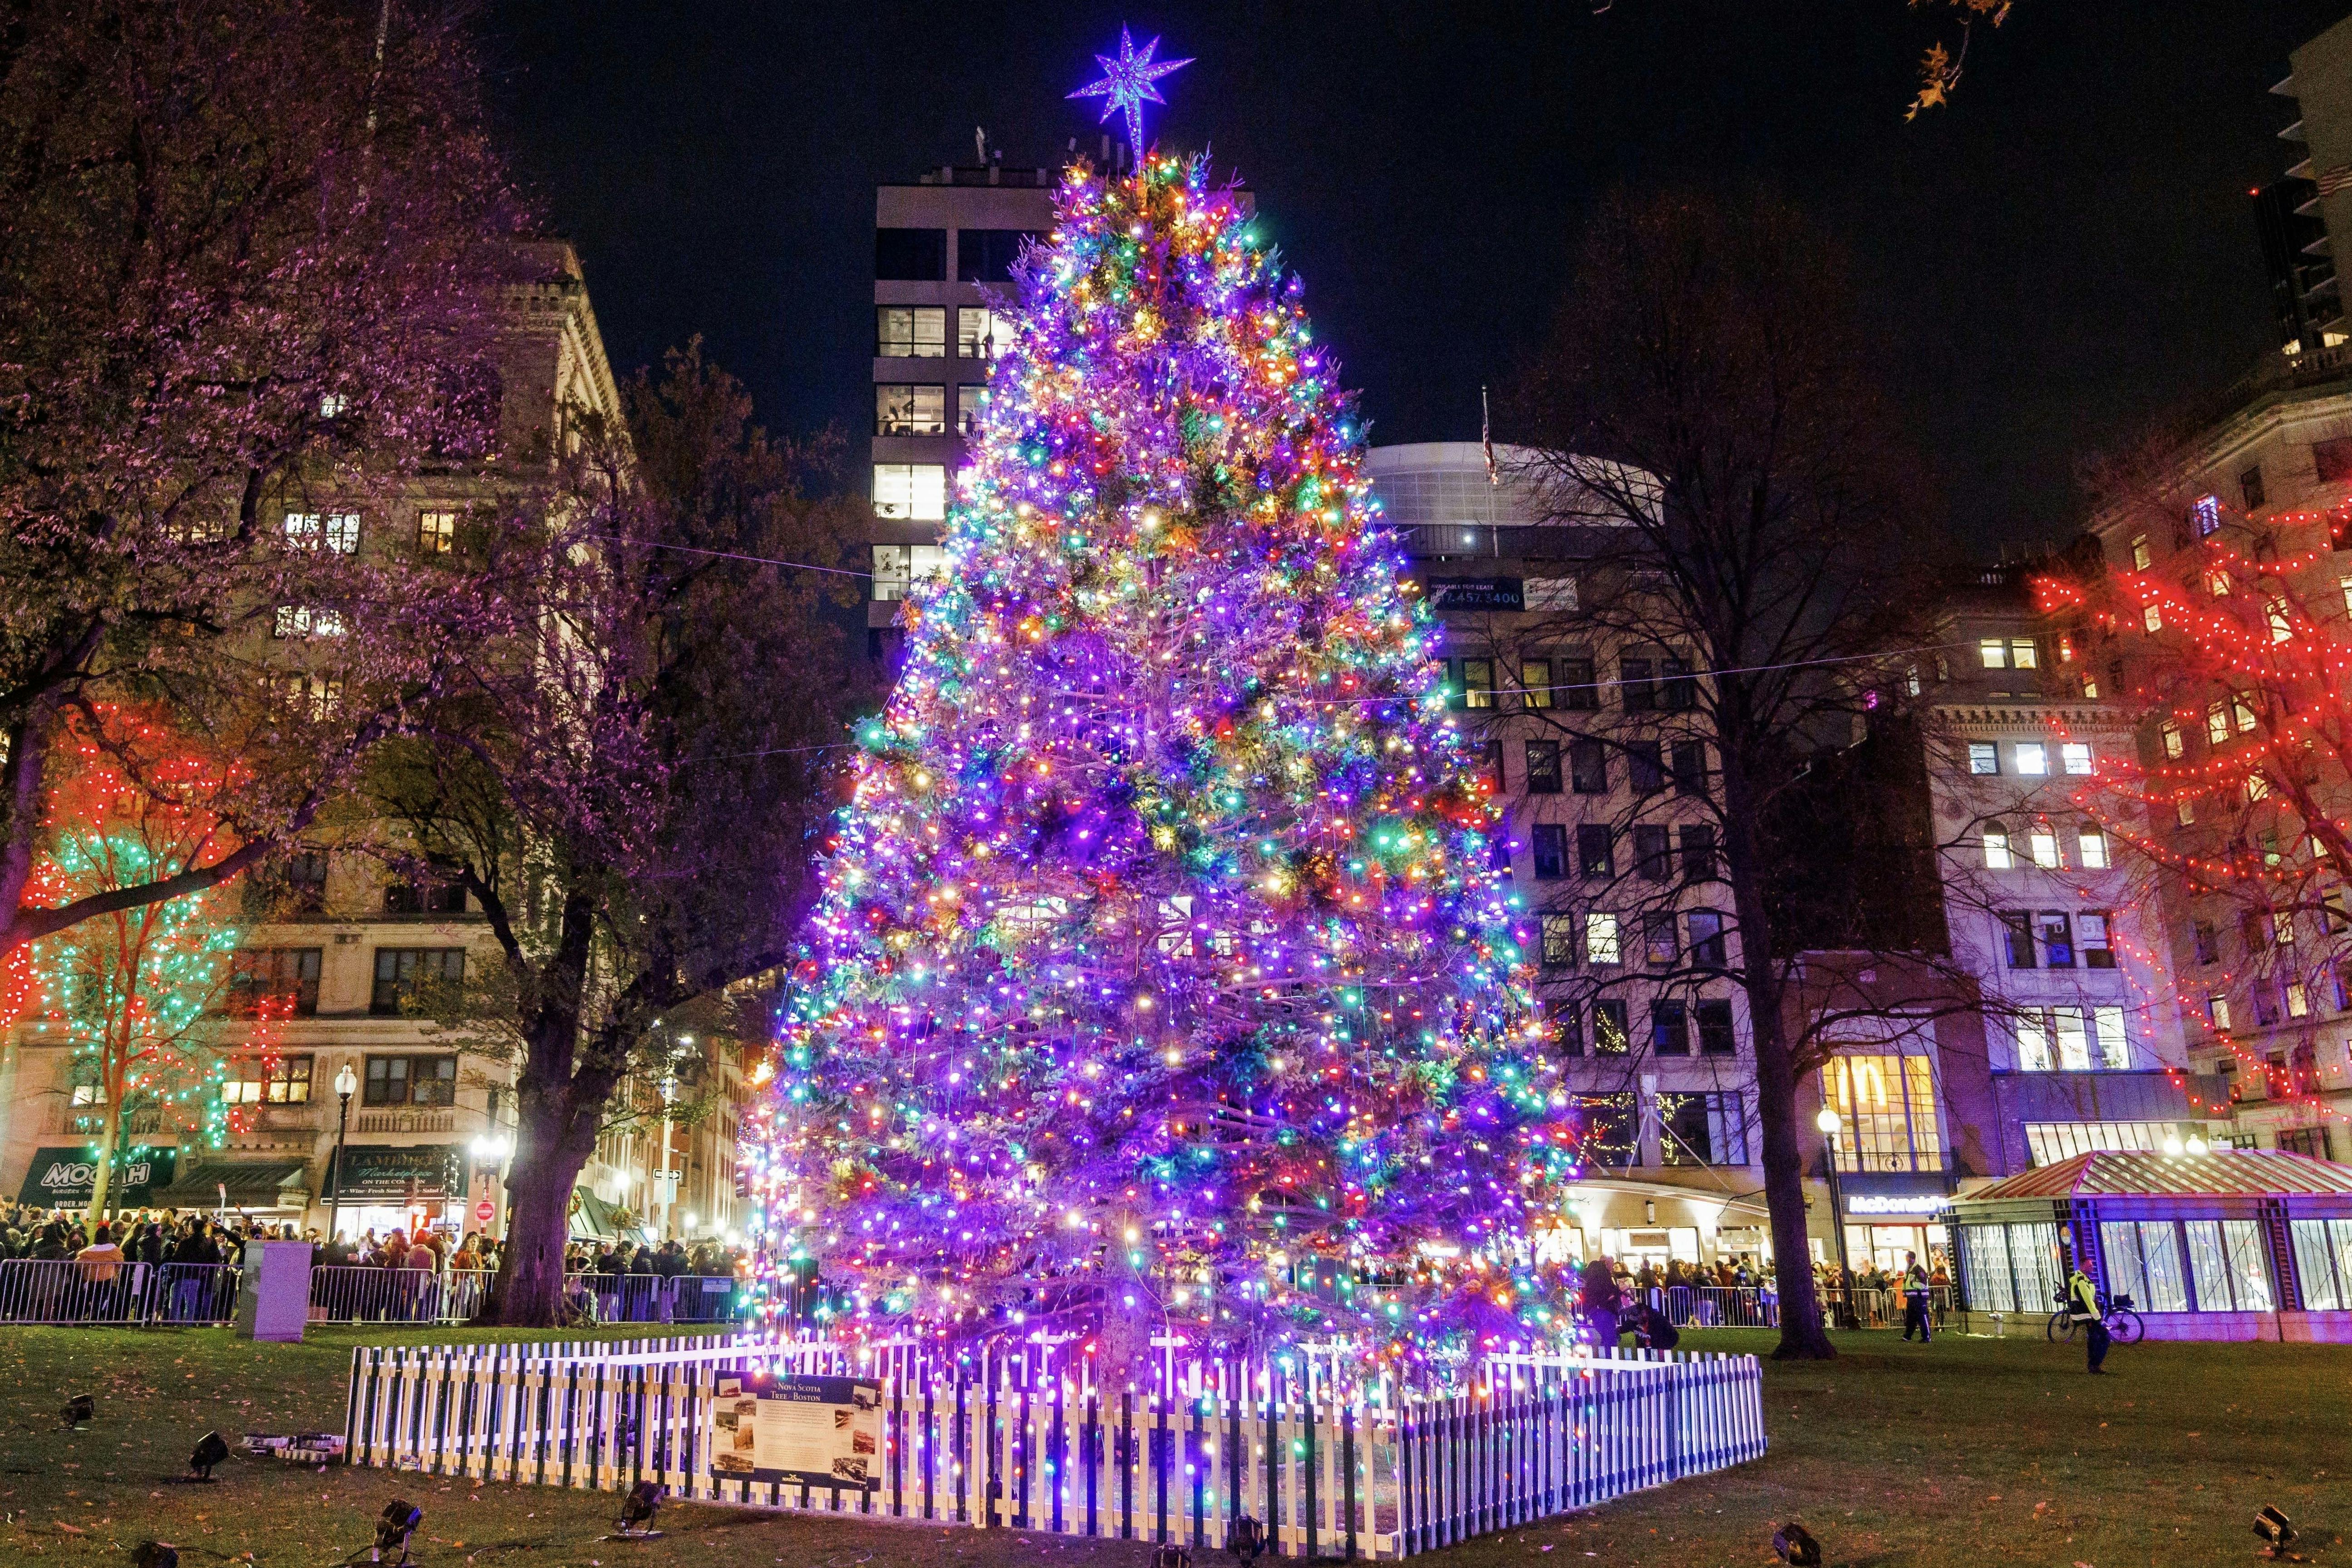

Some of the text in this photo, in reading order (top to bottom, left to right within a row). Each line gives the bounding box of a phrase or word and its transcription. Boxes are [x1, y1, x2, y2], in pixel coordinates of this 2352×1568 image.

[41, 1163, 151, 1186] MOH
[778, 1382, 821, 1392] NOVA SCOTIA
[770, 1391, 787, 1400] TREE
[793, 1392, 821, 1401] BOSTON
